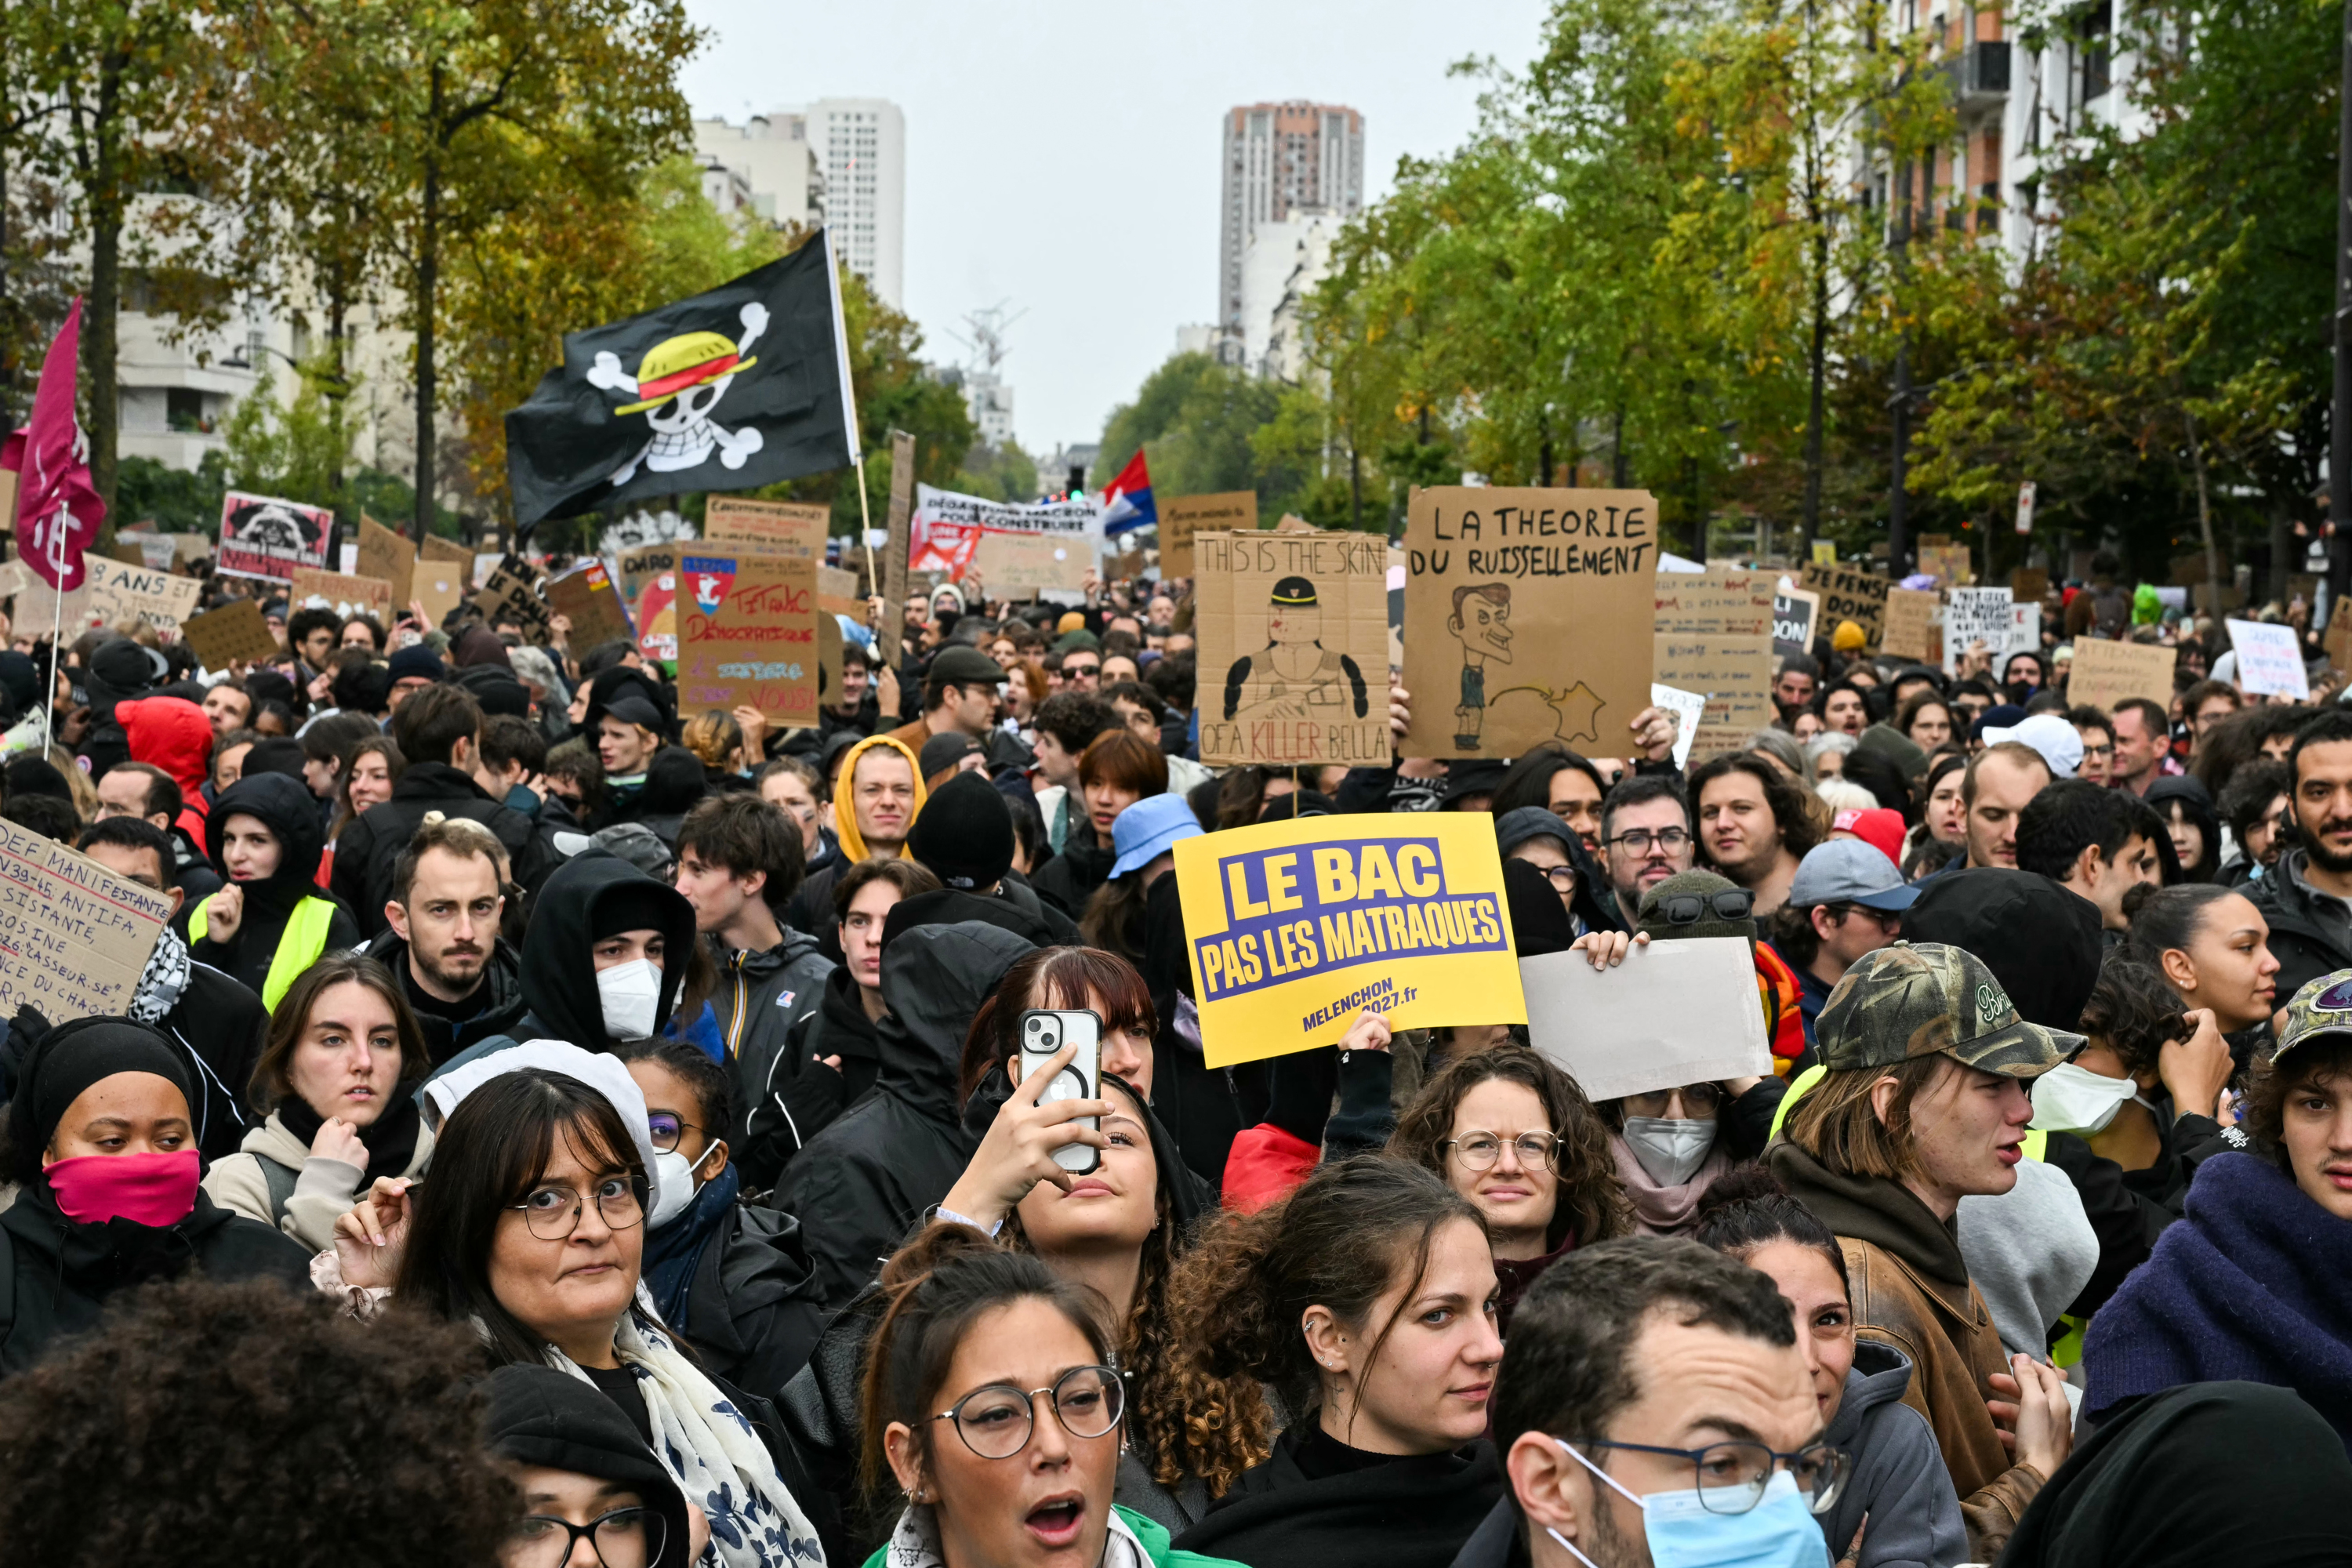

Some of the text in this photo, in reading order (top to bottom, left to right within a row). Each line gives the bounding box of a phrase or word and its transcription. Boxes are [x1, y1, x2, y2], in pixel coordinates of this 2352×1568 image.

[1436, 506, 1646, 540] LA THEORIE
[1198, 539, 1385, 575] THIS IS THE SKIN
[1411, 543, 1653, 579] DU RUISSELLEMENT
[110, 570, 166, 596] ANS
[1806, 566, 1831, 587] JE
[1828, 596, 1882, 622] DONC
[1201, 720, 1387, 760] OF A KILLER BELLA
[1228, 844, 1439, 920] LE BAC
[60, 891, 136, 938] ANTIFA,
[1201, 898, 1501, 993] PAS LES MATRAQUES
[34, 975, 53, 992] DU
[1302, 977, 1393, 1033] MELENCHON
